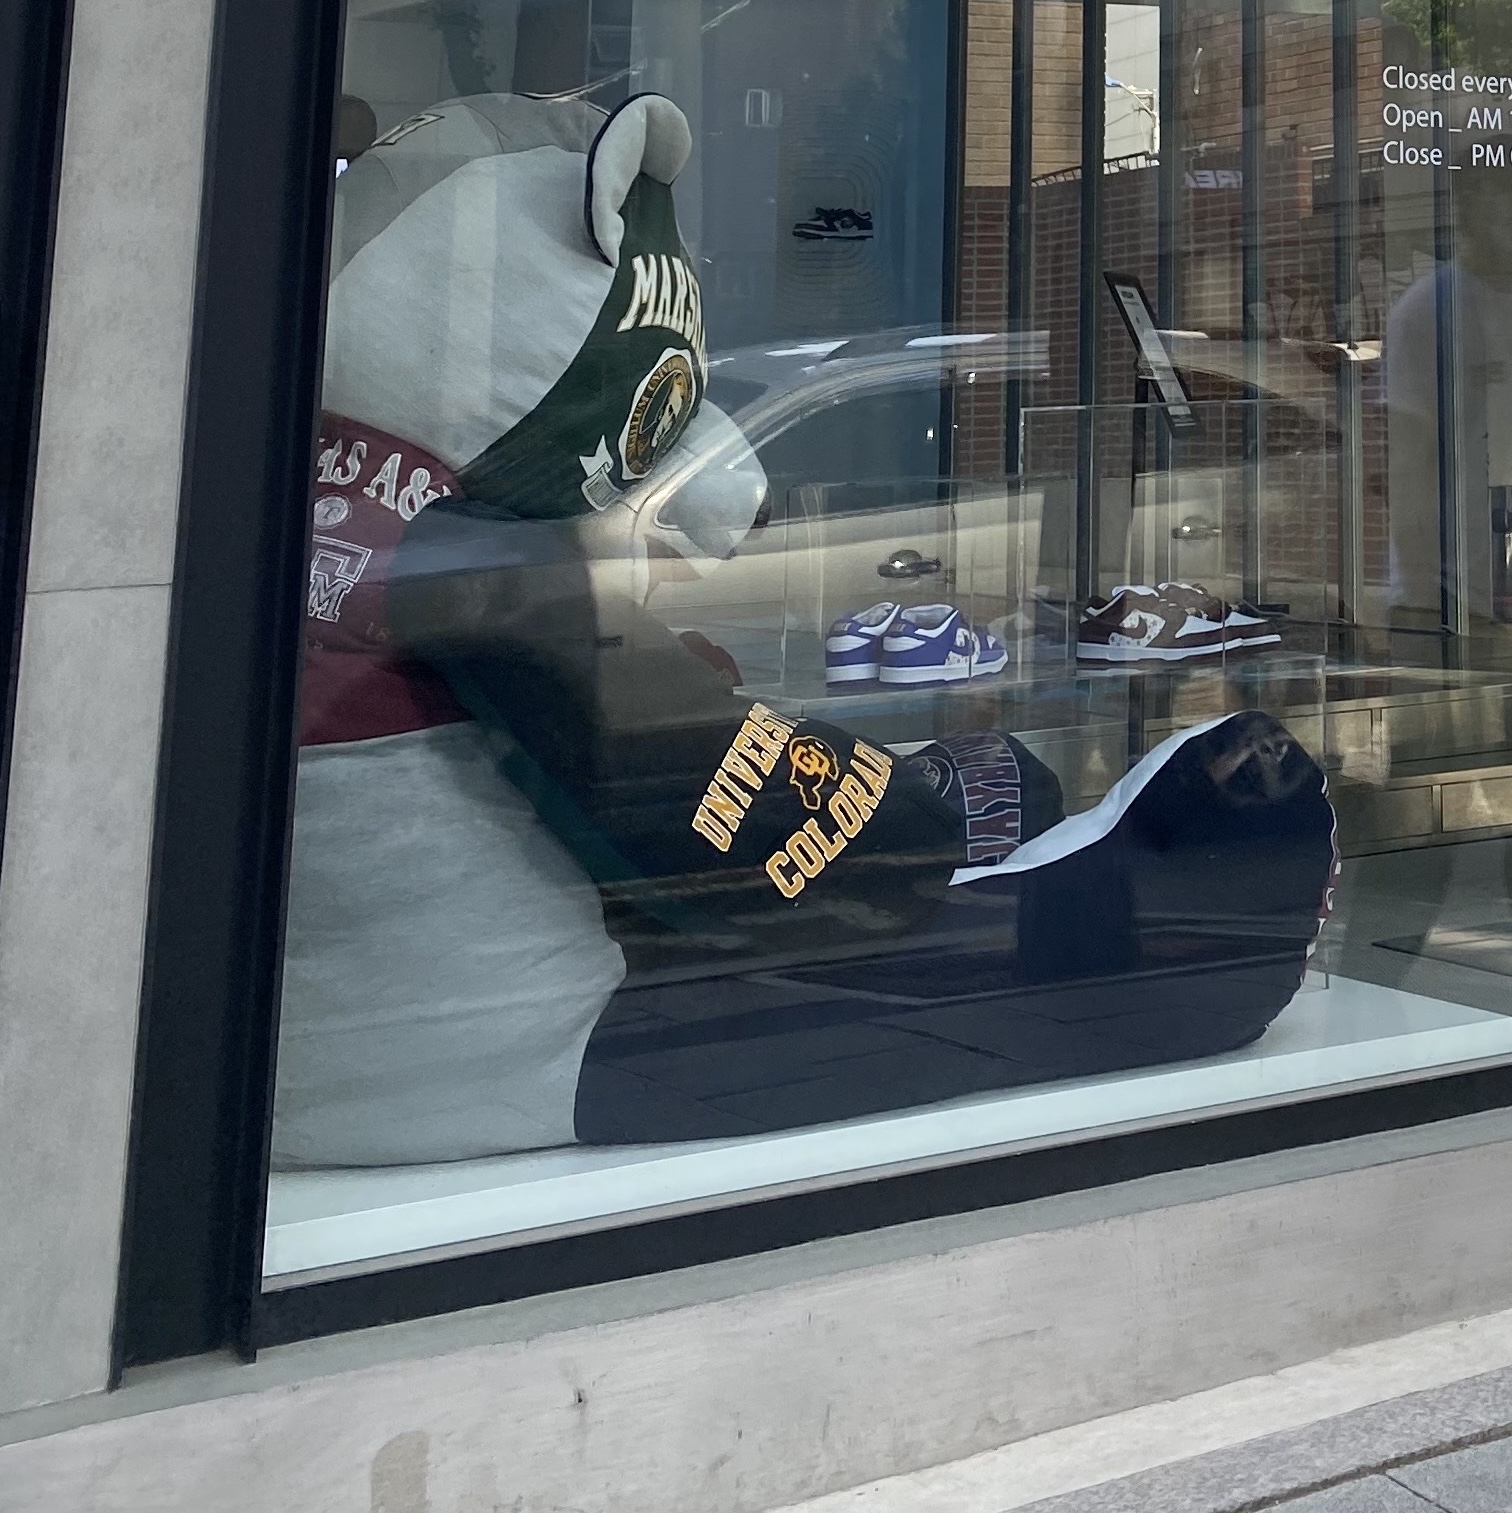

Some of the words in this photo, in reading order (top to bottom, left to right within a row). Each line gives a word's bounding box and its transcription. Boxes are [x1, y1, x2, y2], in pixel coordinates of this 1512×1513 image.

[1383, 65, 1455, 91] Closed
[1383, 103, 1443, 132] Open
[1466, 107, 1502, 130] AM
[1383, 141, 1443, 166] Close
[1472, 144, 1505, 168] PM
